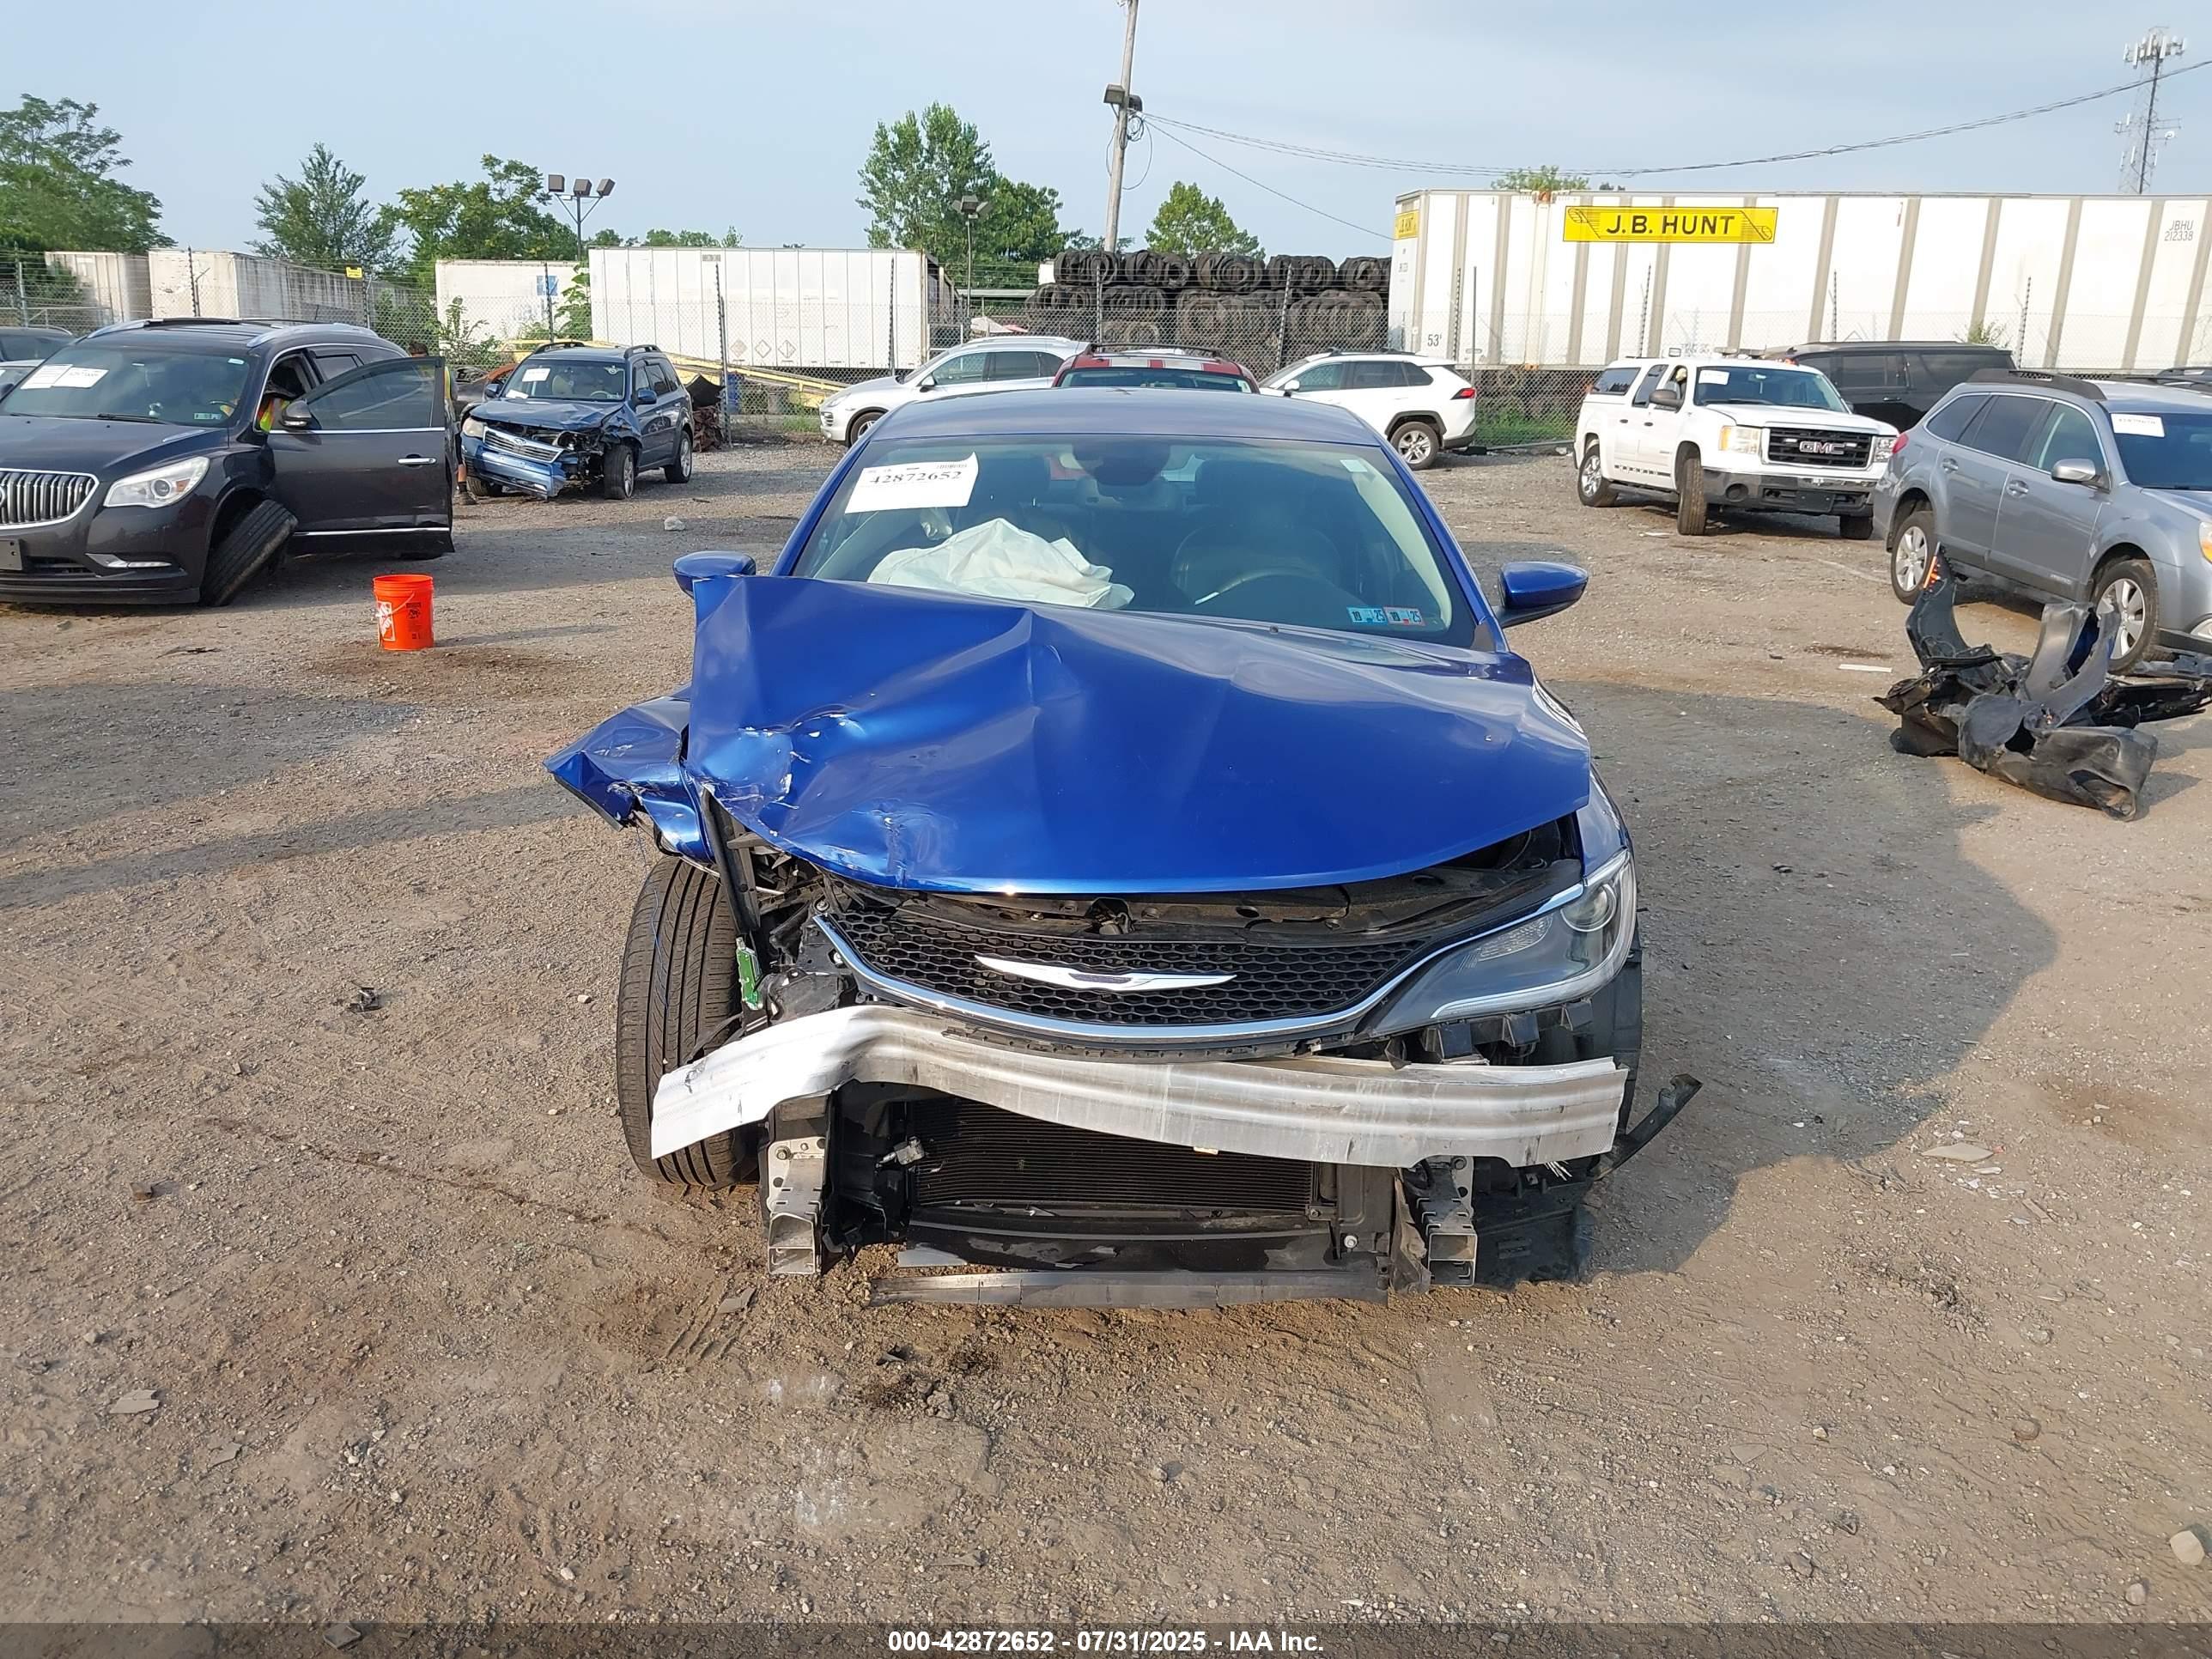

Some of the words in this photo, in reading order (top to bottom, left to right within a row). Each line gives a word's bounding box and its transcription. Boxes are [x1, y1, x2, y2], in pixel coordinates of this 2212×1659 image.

[1606, 215, 1653, 234] J.B.
[1662, 215, 1735, 234] HUNT
[2168, 220, 2194, 231] JBHU
[2164, 230, 2194, 241] 212338
[1426, 333, 1443, 347] 53'
[1799, 441, 1844, 455] GMC
[869, 471, 963, 484] 42872652
[1374, 610, 1385, 622] 25
[1410, 611, 1422, 623] 25
